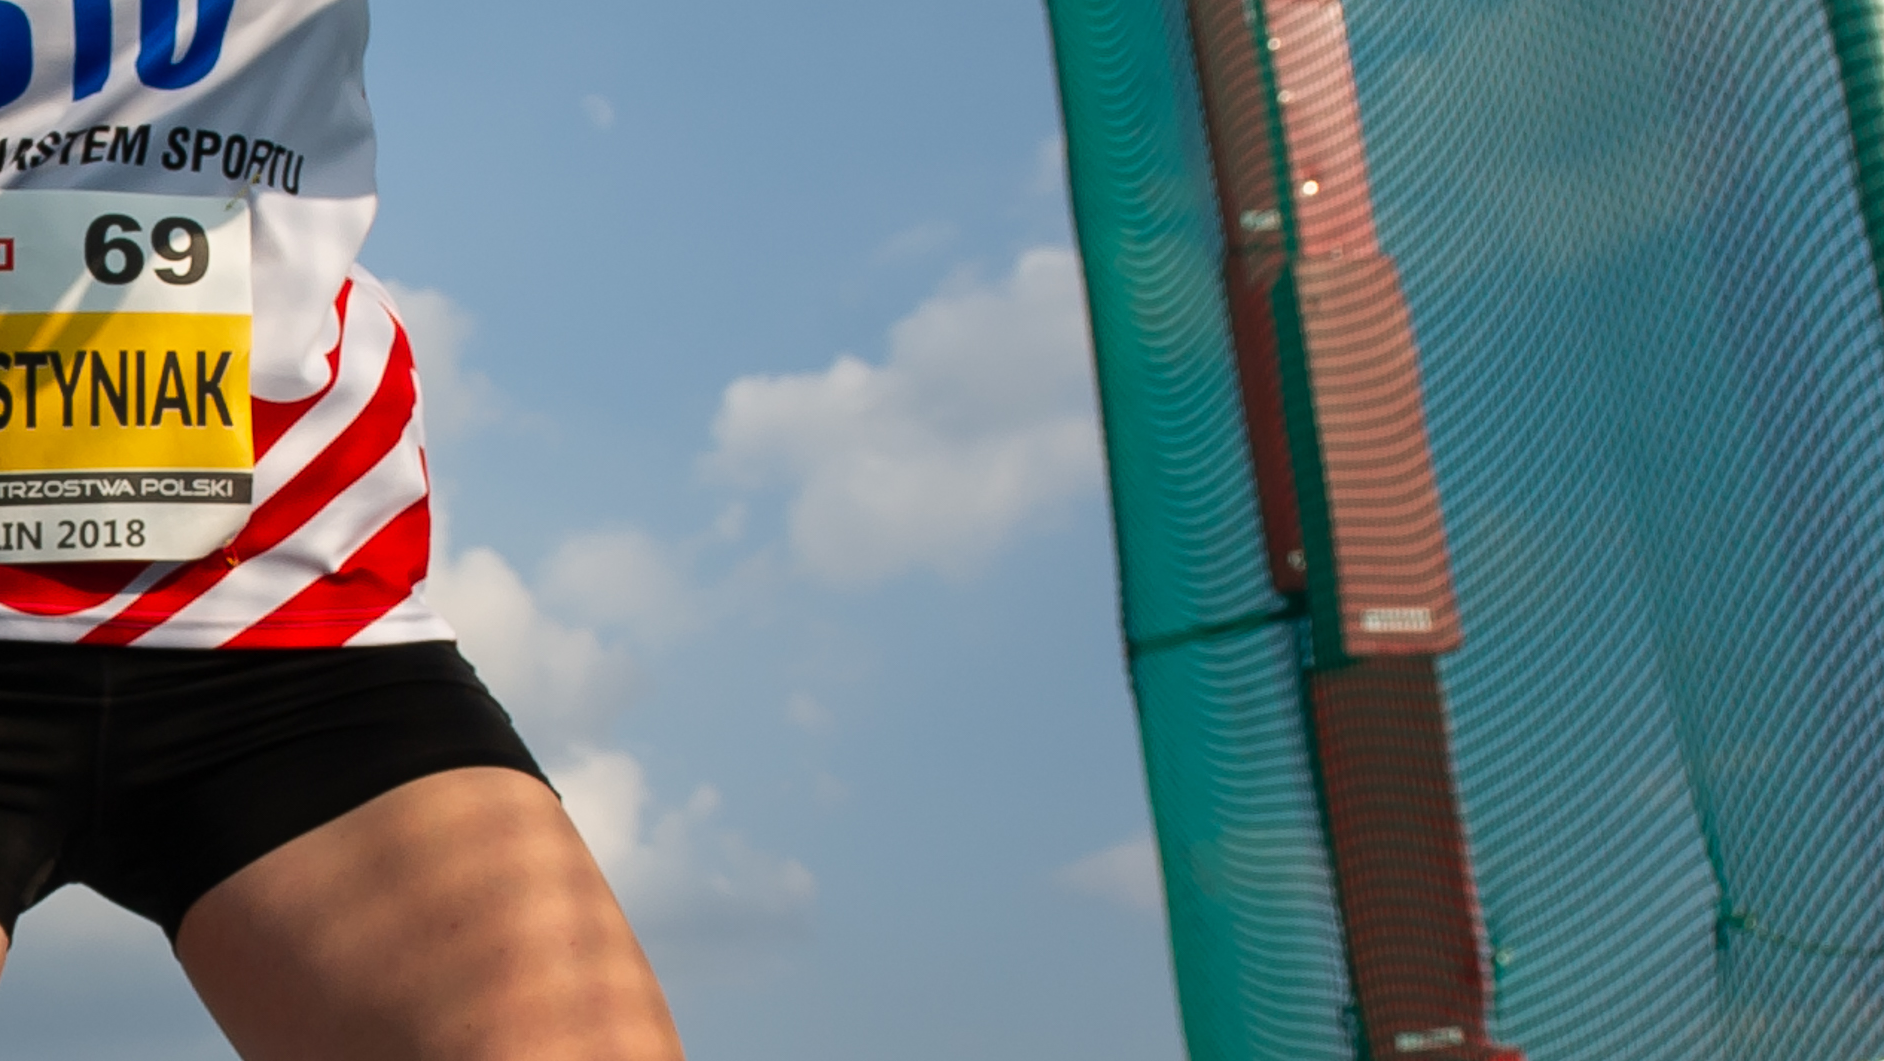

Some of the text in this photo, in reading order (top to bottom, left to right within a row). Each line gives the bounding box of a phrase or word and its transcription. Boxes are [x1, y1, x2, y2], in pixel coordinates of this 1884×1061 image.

[161, 127, 304, 196] SPORTU
[84, 213, 210, 286] 69
[141, 478, 233, 498] POLSKI
[57, 519, 146, 549] 2018
